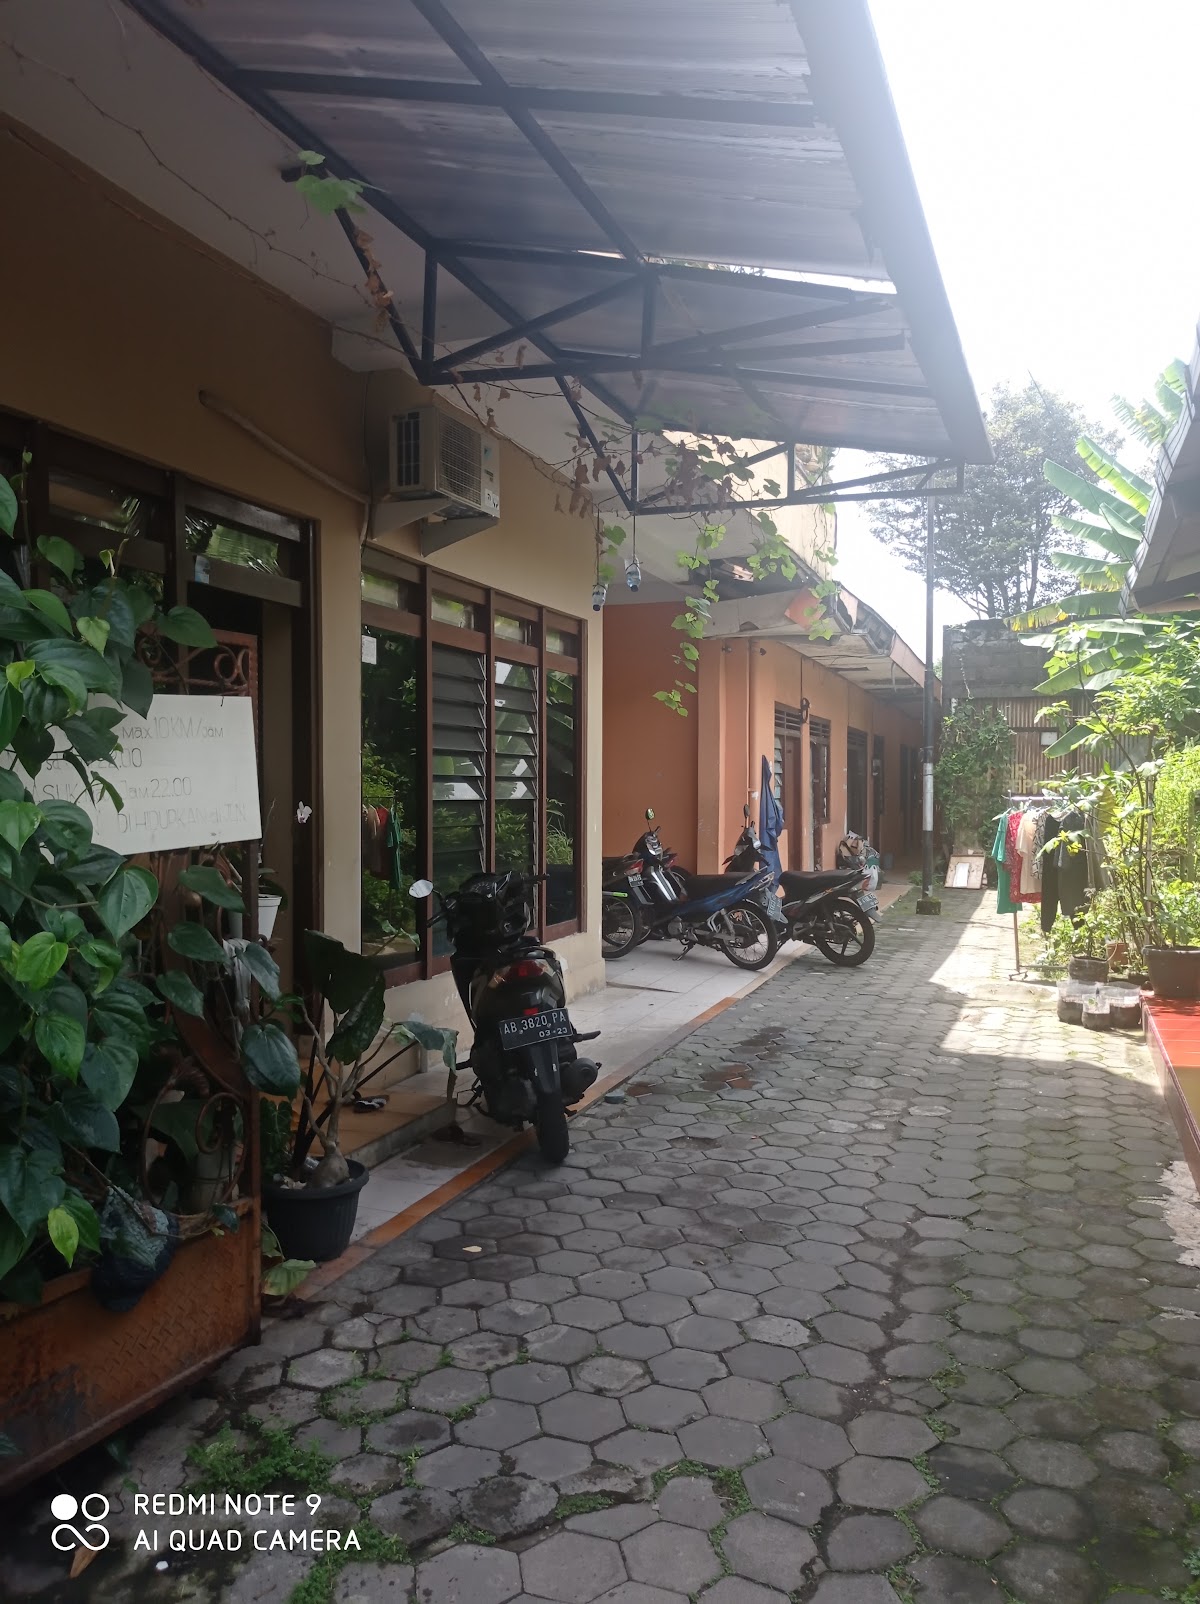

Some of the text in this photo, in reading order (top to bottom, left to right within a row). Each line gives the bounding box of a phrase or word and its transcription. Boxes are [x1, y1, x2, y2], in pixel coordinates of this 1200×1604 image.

[150, 776, 193, 798] 22.00
[504, 1011, 566, 1034] AB 3820 PA
